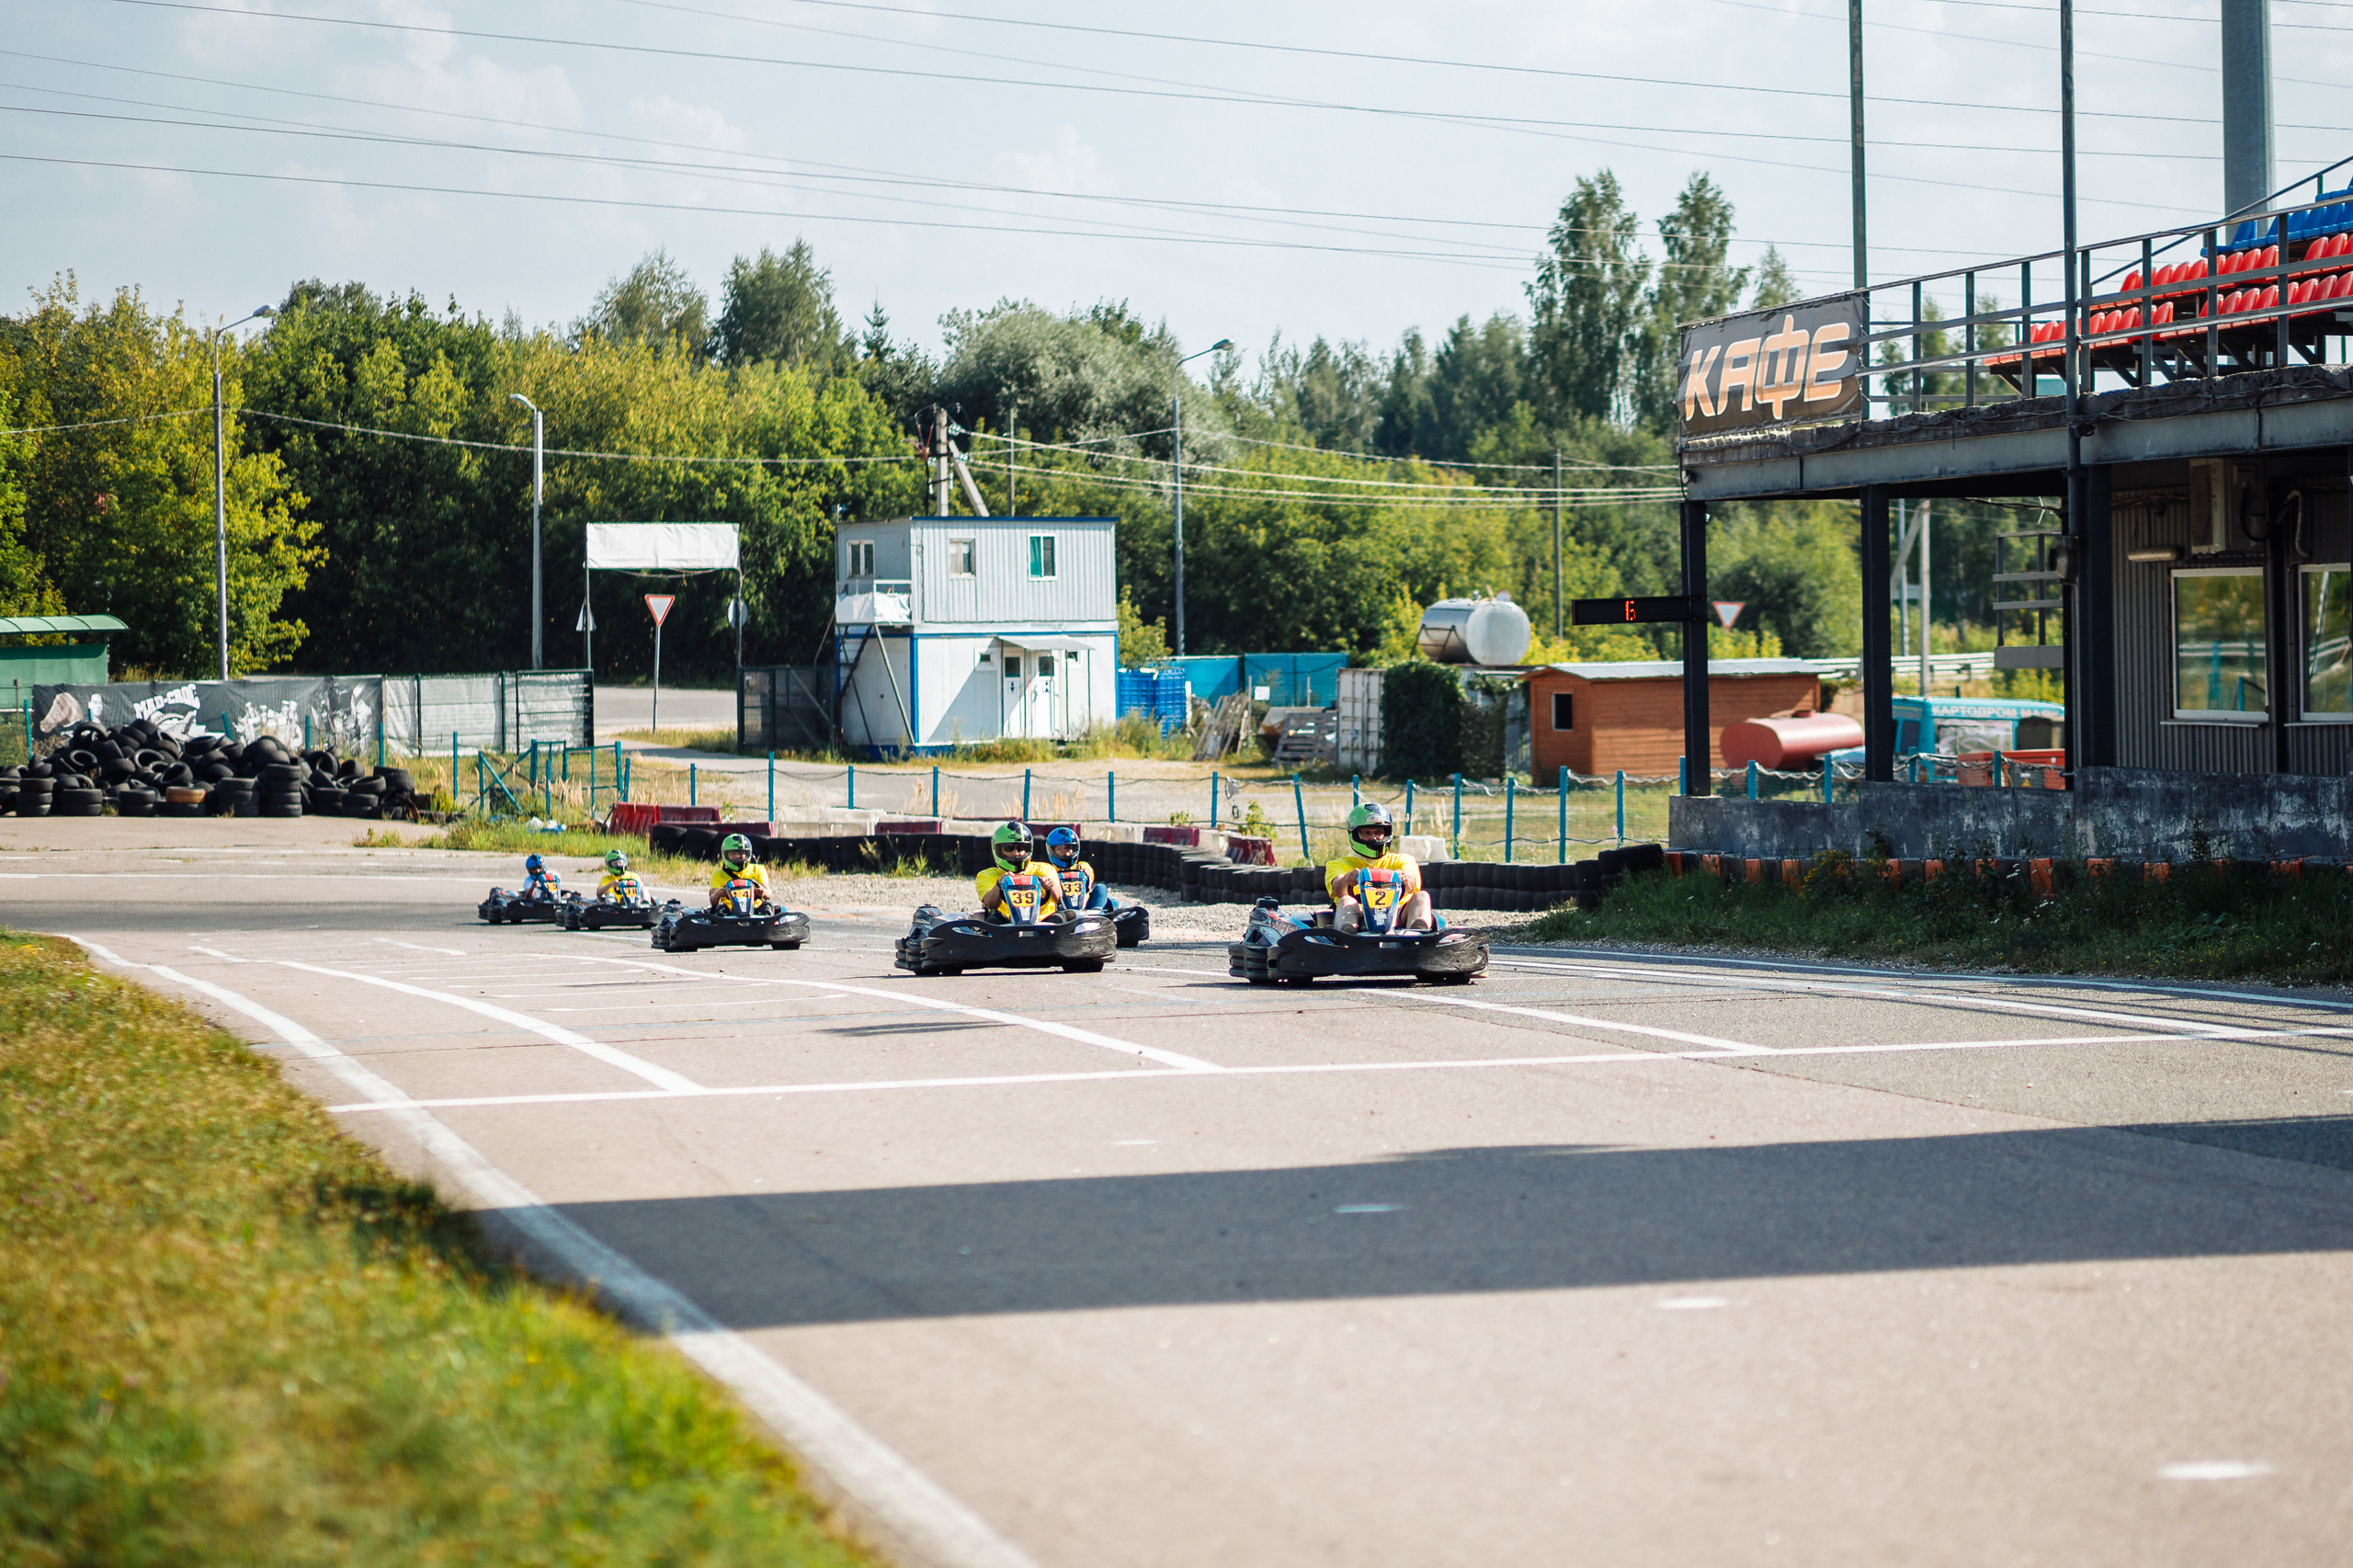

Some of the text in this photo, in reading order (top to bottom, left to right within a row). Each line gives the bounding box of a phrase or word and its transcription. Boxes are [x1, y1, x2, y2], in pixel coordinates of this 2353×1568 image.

[1686, 314, 1850, 421] КАФЕ
[1932, 705, 2017, 718] КАРТОДРОМ
[1063, 882, 1082, 892] 33
[1012, 892, 1035, 904] 39
[1374, 891, 1386, 905] 2
